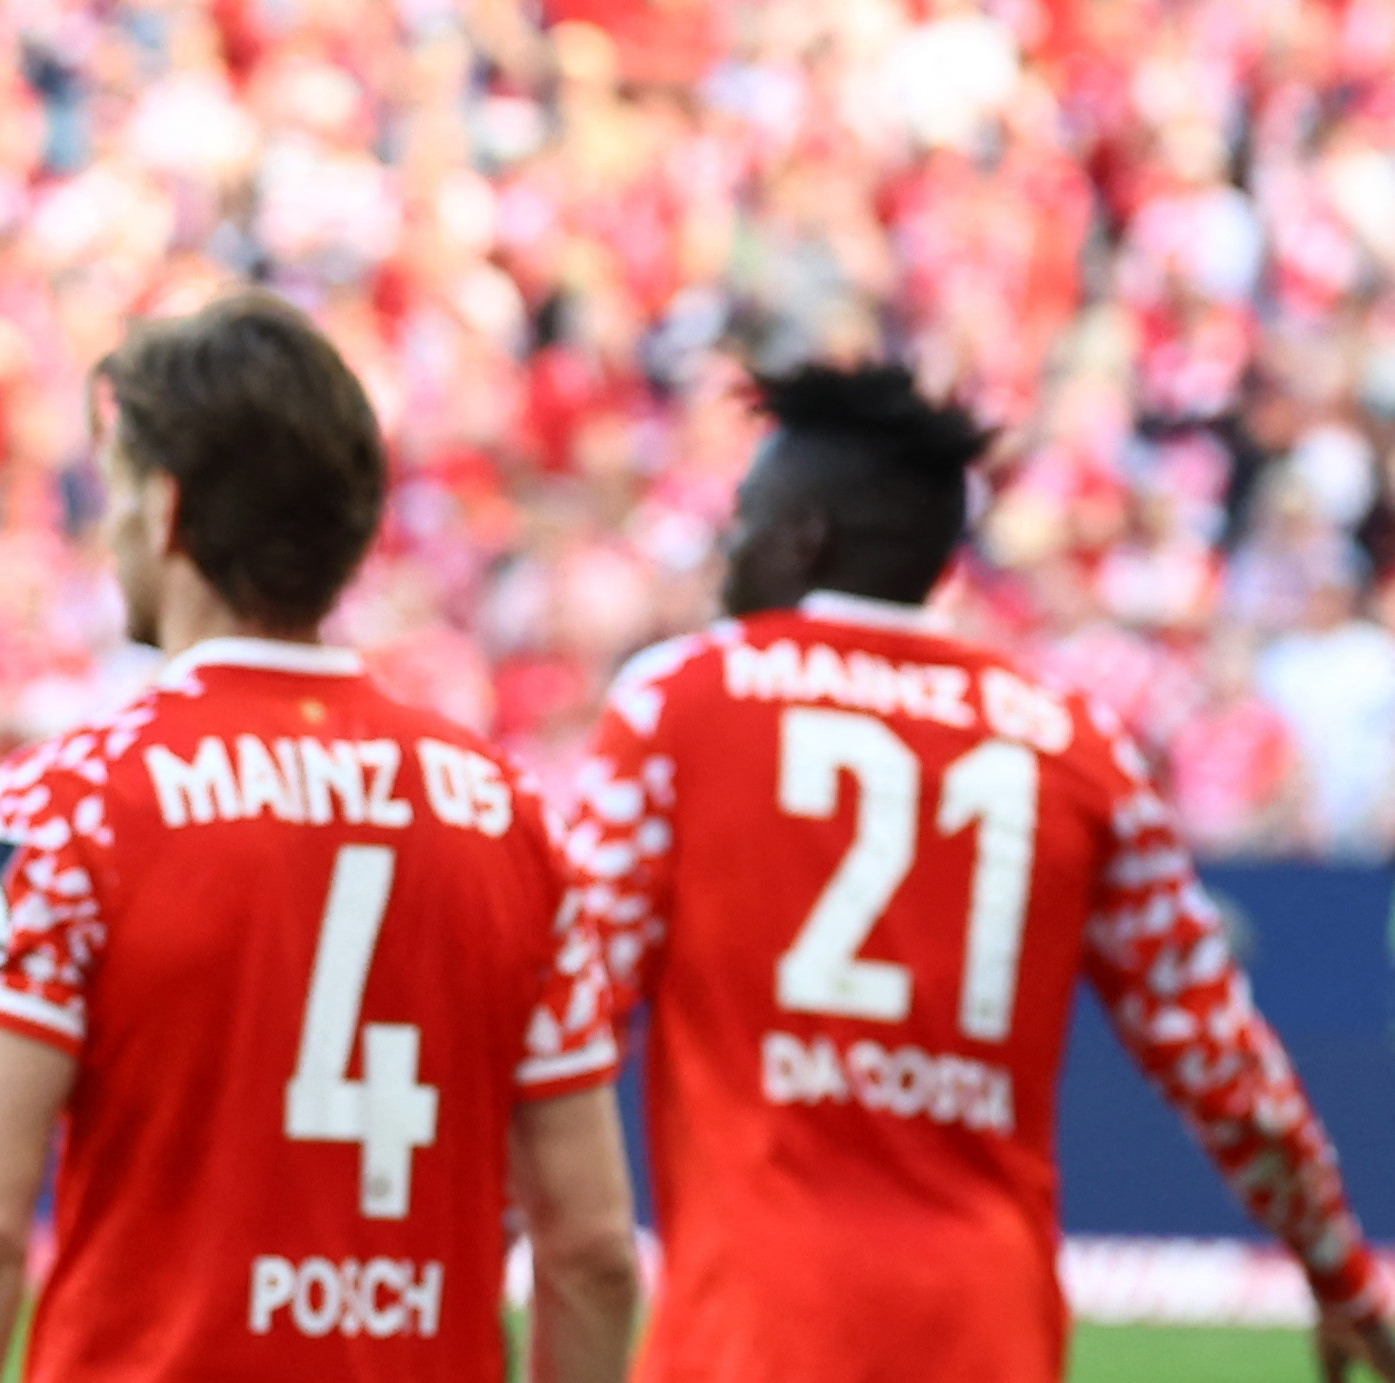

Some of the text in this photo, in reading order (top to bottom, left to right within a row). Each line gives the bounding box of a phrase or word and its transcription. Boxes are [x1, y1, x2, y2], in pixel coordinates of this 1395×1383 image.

[723, 638, 976, 729] MAINZ
[143, 735, 512, 837] MAINZ 05
[775, 705, 1041, 1044] 21
[283, 843, 439, 1220] 4
[760, 1030, 851, 1106] DA
